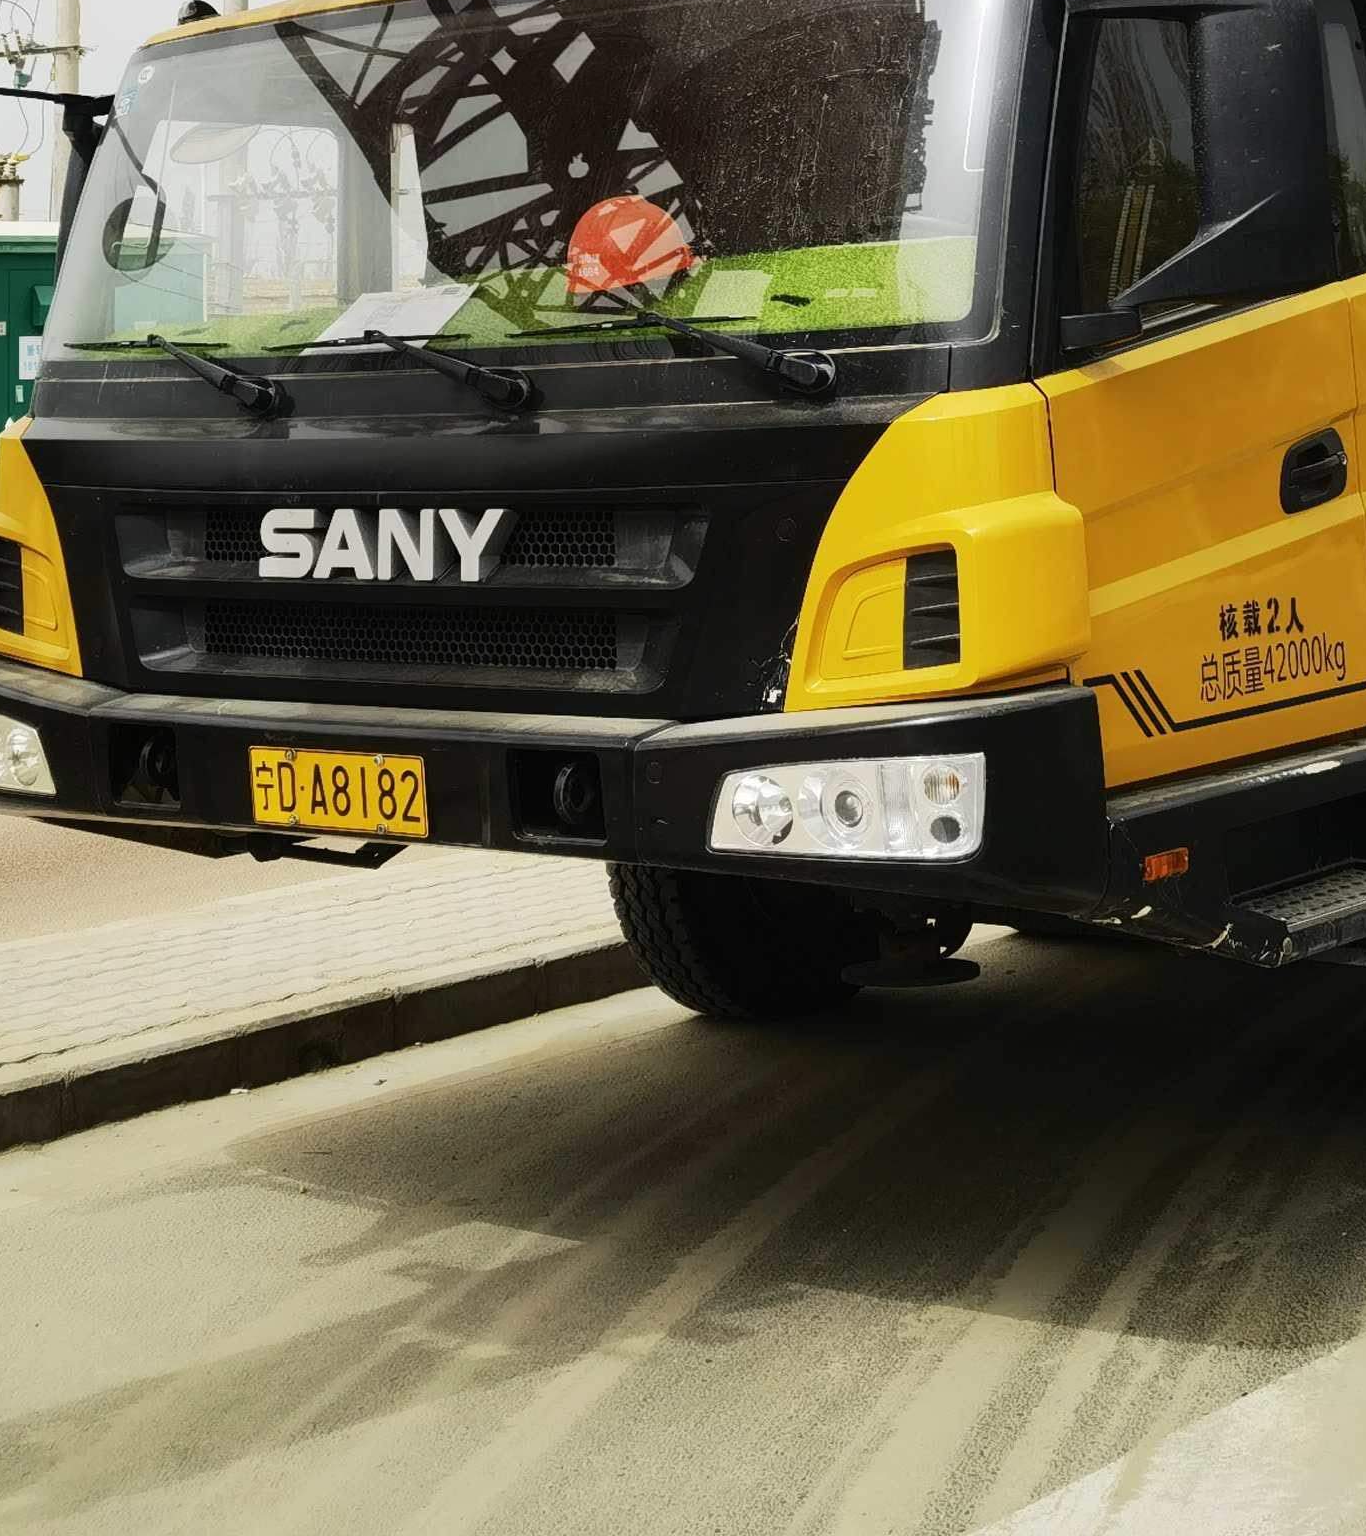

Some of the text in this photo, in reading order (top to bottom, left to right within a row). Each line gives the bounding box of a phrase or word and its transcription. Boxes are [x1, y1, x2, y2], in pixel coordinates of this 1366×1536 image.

[259, 508, 504, 582] SANY
[1219, 597, 1304, 641] 核载2人
[1200, 632, 1347, 702] 总质量42000kg
